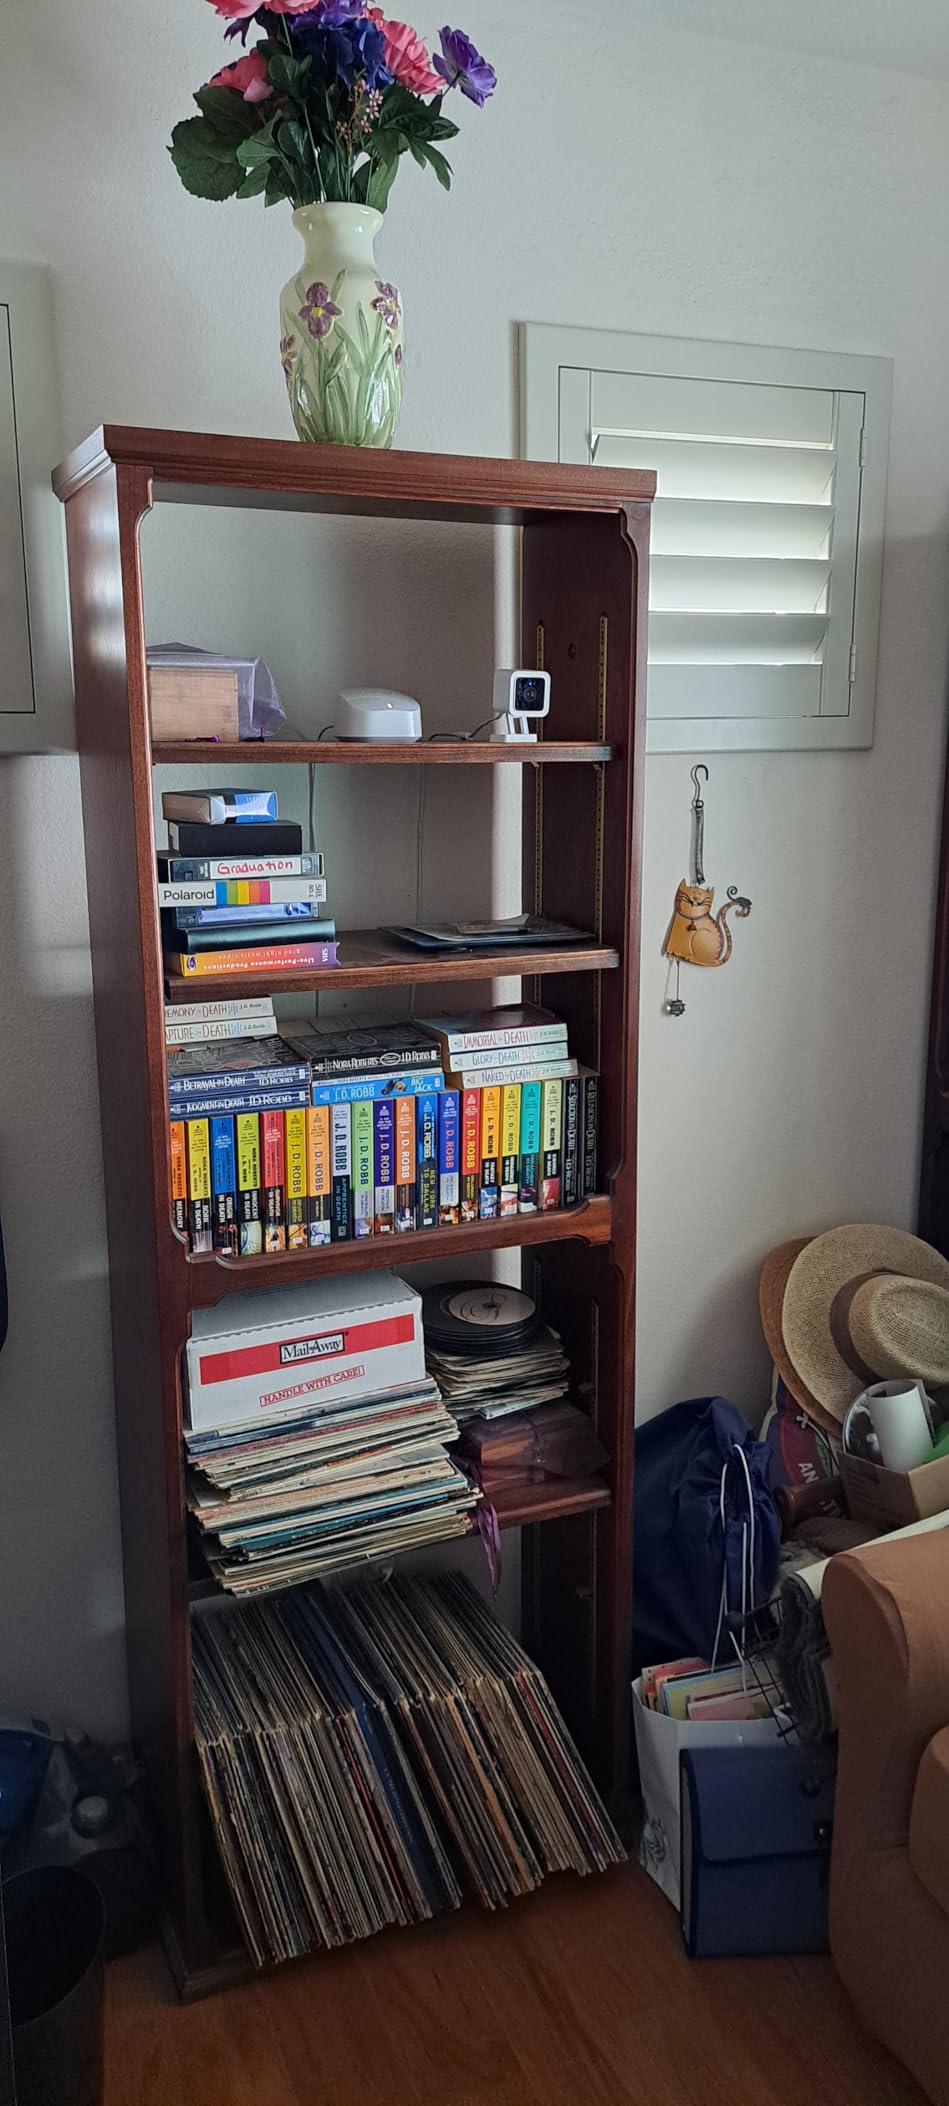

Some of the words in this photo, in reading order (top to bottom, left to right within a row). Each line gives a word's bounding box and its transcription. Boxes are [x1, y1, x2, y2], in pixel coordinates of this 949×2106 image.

[217, 860, 293, 874] Graduation
[164, 889, 214, 900] Polaroid
[204, 962, 248, 970] Productions
[203, 1004, 227, 1018] DEATH
[203, 1023, 230, 1038] DEATH
[464, 1035, 498, 1049] IMMORTAL
[504, 1031, 528, 1044] DEATH
[412, 1051, 430, 1060] ROBB
[472, 1053, 492, 1065] GLORY
[499, 1051, 519, 1064] DEATH
[333, 1059, 351, 1069] NORA
[352, 1057, 378, 1068] ROBERTS
[269, 1077, 293, 1085] ROBB
[482, 1069, 504, 1083] NAKED
[510, 1068, 531, 1081] DEATH
[184, 1081, 217, 1091] BETRAYAL
[224, 1076, 246, 1086] DEATH
[411, 1078, 423, 1086] BIG
[414, 1083, 432, 1092] JACK
[351, 1087, 375, 1098] ROBB
[186, 1101, 217, 1113] JUDGMENT
[225, 1098, 245, 1108] DEATH
[263, 1095, 292, 1105] ROBB
[568, 1095, 577, 1122] SEDUCTION
[424, 1113, 431, 1122] J.
[334, 1123, 346, 1132] J.
[424, 1122, 431, 1132] D.
[446, 1120, 454, 1128] J.
[335, 1135, 347, 1144] D.
[446, 1130, 454, 1140] D.
[467, 1130, 475, 1139] D.
[567, 1130, 576, 1150] DEATH
[586, 1130, 595, 1150] DEATH
[380, 1143, 389, 1153] D.
[401, 1140, 409, 1149] D.
[360, 1146, 368, 1155] D.
[446, 1142, 454, 1168] ROBB
[467, 1142, 475, 1168] ROBB
[292, 1154, 301, 1163] D.
[314, 1152, 323, 1161] D.
[335, 1146, 347, 1170] ROBB
[381, 1155, 389, 1183] ROBB
[402, 1151, 410, 1178] ROBB
[315, 1164, 324, 1191] ROBB
[360, 1159, 369, 1185] ROBB
[424, 1168, 430, 1178] TO
[292, 1166, 301, 1193] ROBB
[336, 1186, 341, 1194] IN
[264, 1386, 303, 1404] HANDLE
[306, 1377, 331, 1390] WITH
[334, 1368, 361, 1381] CARE!
